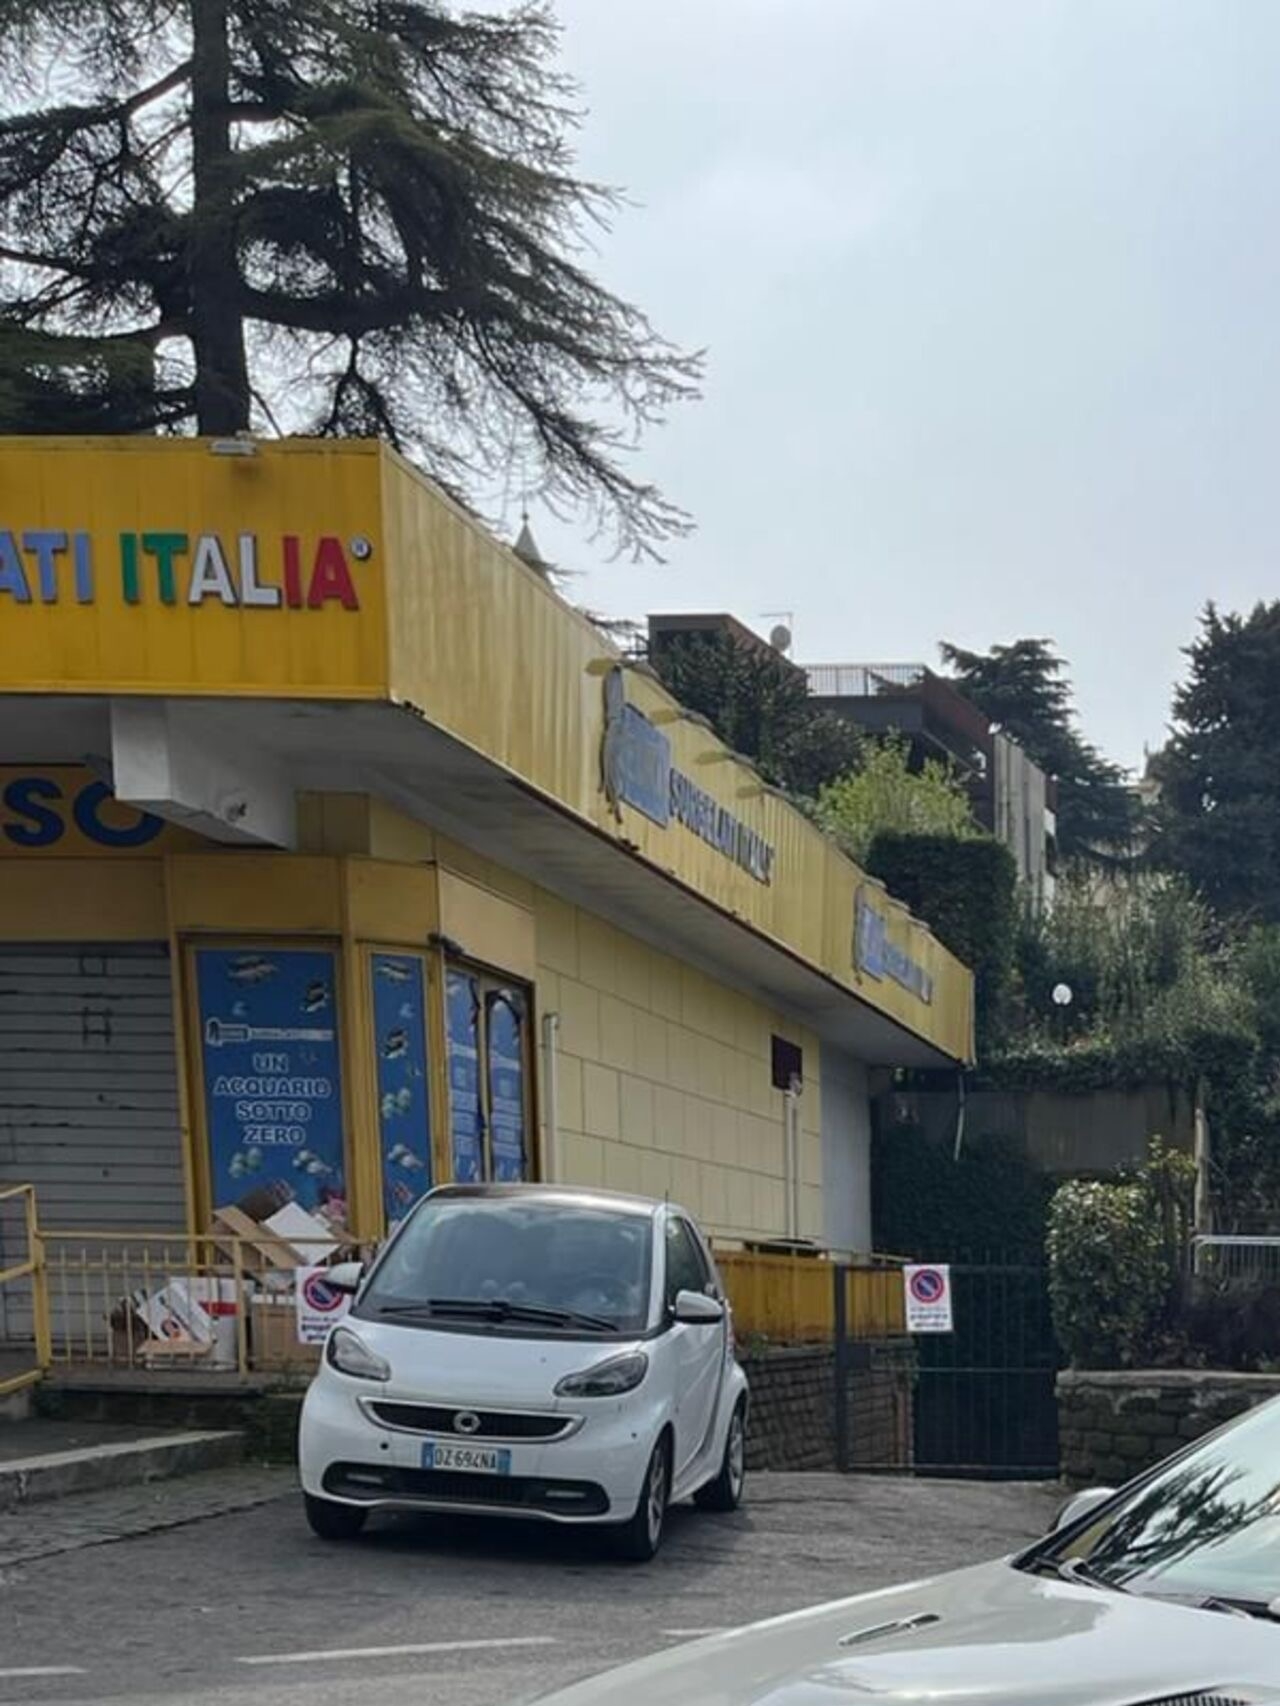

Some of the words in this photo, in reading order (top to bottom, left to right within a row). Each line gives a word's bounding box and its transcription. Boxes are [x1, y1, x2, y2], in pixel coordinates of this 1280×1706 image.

[119, 532, 360, 611] ITALIA
[252, 1052, 290, 1074] UN
[212, 1075, 333, 1099] ACQUARIO
[235, 1099, 313, 1122] SOTTO
[241, 1123, 307, 1146] ZERO
